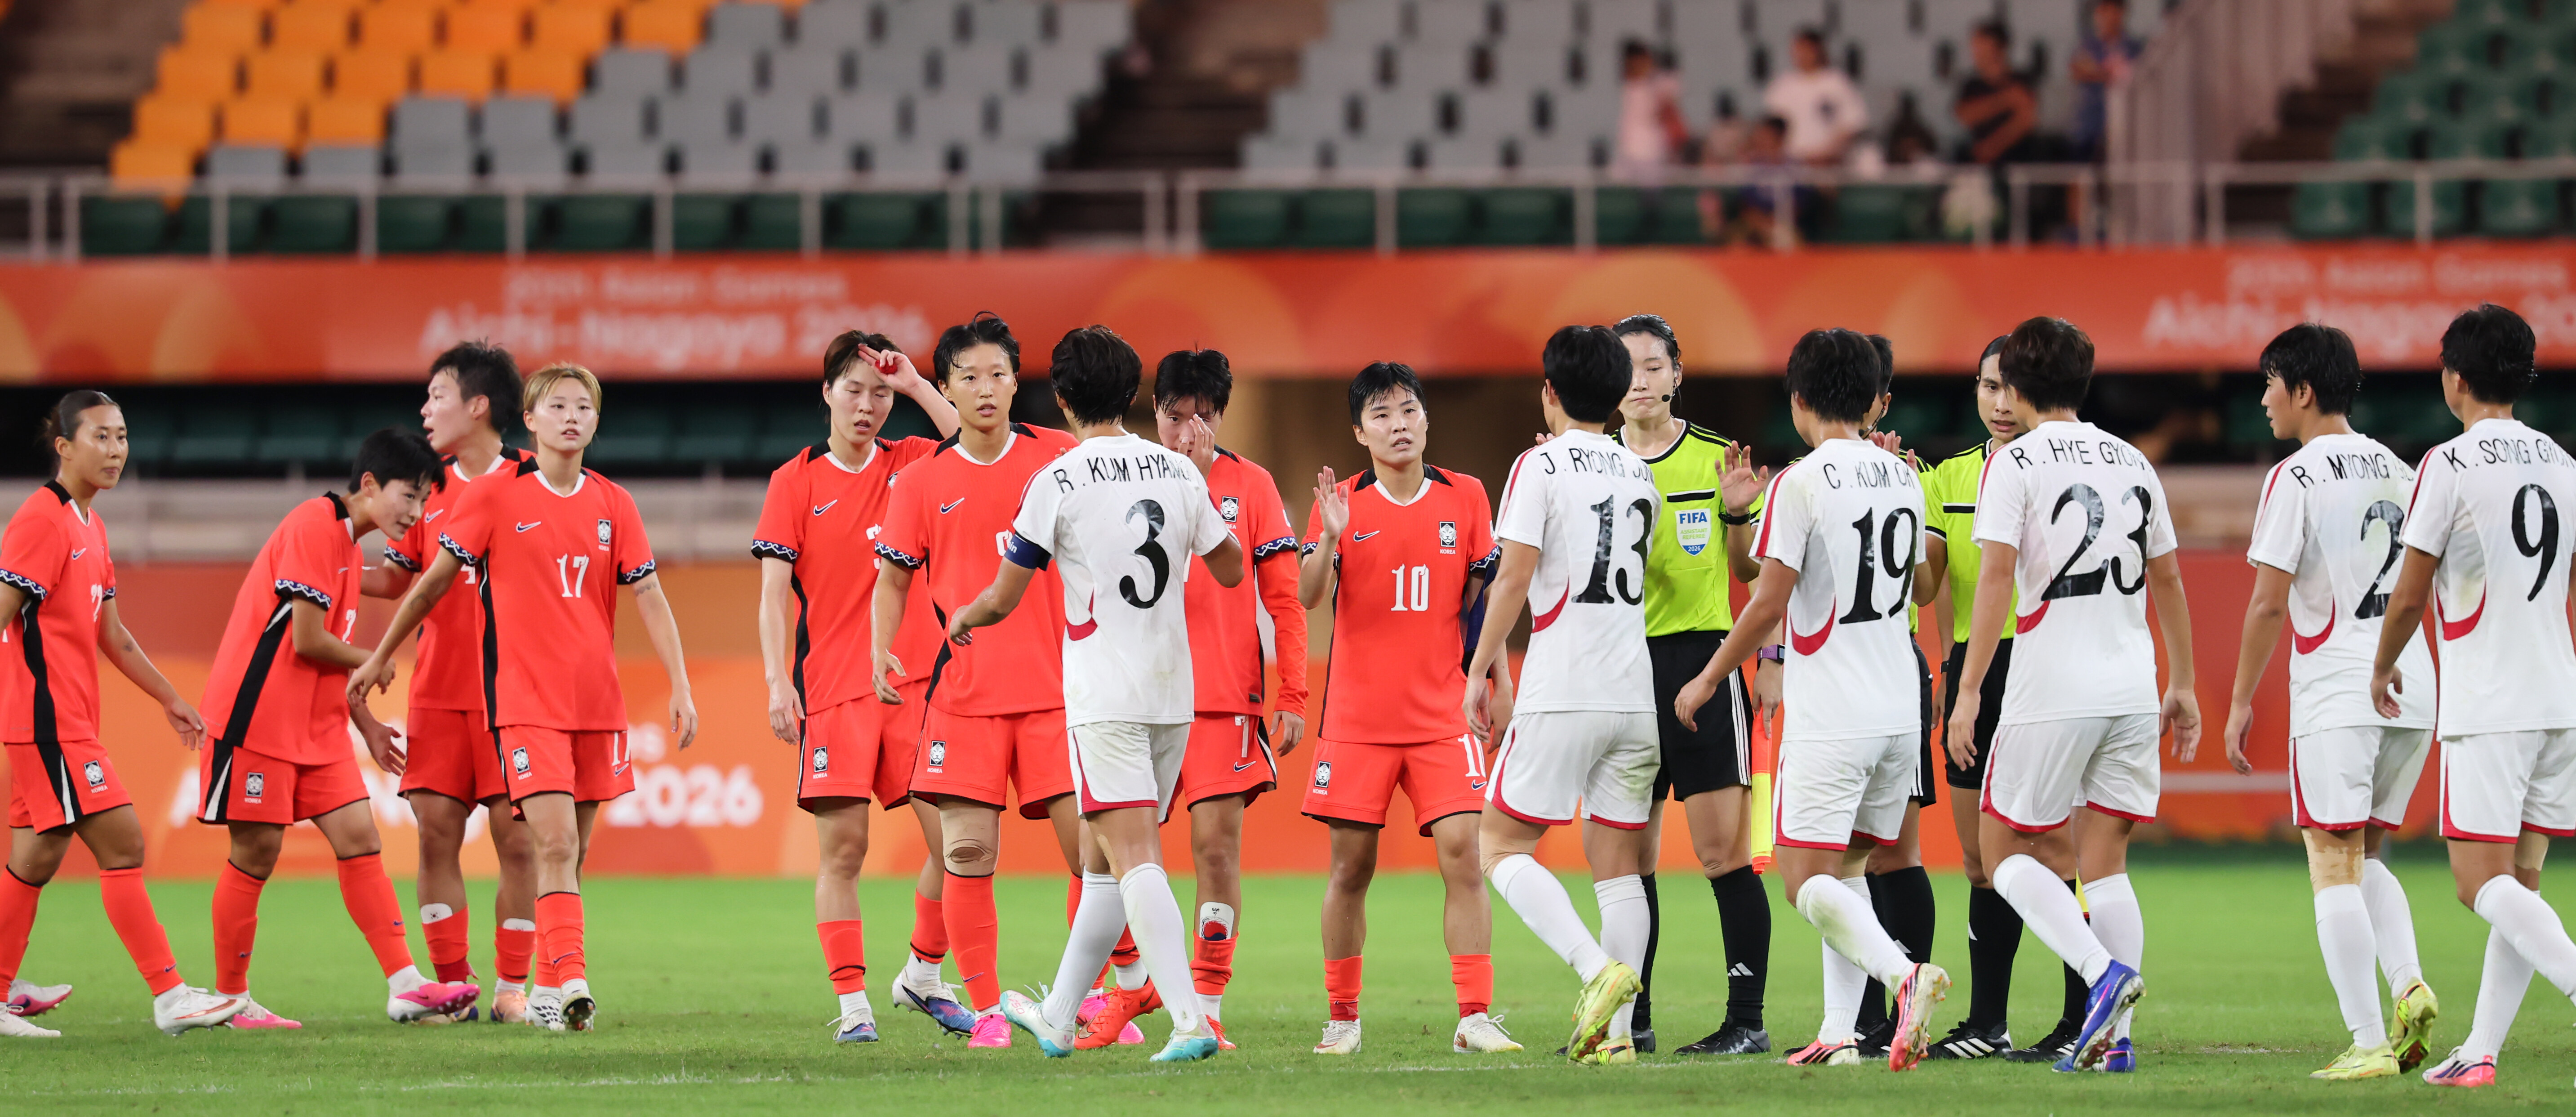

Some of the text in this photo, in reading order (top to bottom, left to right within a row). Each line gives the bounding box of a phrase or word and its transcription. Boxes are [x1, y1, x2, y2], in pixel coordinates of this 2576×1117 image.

[1087, 457, 1131, 483] KUM
[1568, 448, 1625, 477] RYONG
[2048, 438, 2092, 464] HYE
[2327, 454, 2389, 480] MYONG
[2479, 438, 2531, 464] SONG
[1854, 461, 1891, 487] KUM
[1679, 512, 1707, 524] FIFA
[1119, 500, 1170, 609] 3
[1572, 495, 1652, 606] 13
[2041, 483, 2152, 601] 23
[2354, 500, 2405, 619] 2
[2512, 483, 2559, 602] 9
[556, 553, 589, 598] 17
[1391, 563, 1429, 611] 10
[1839, 507, 1917, 624] 19
[1234, 715, 1249, 758] 7
